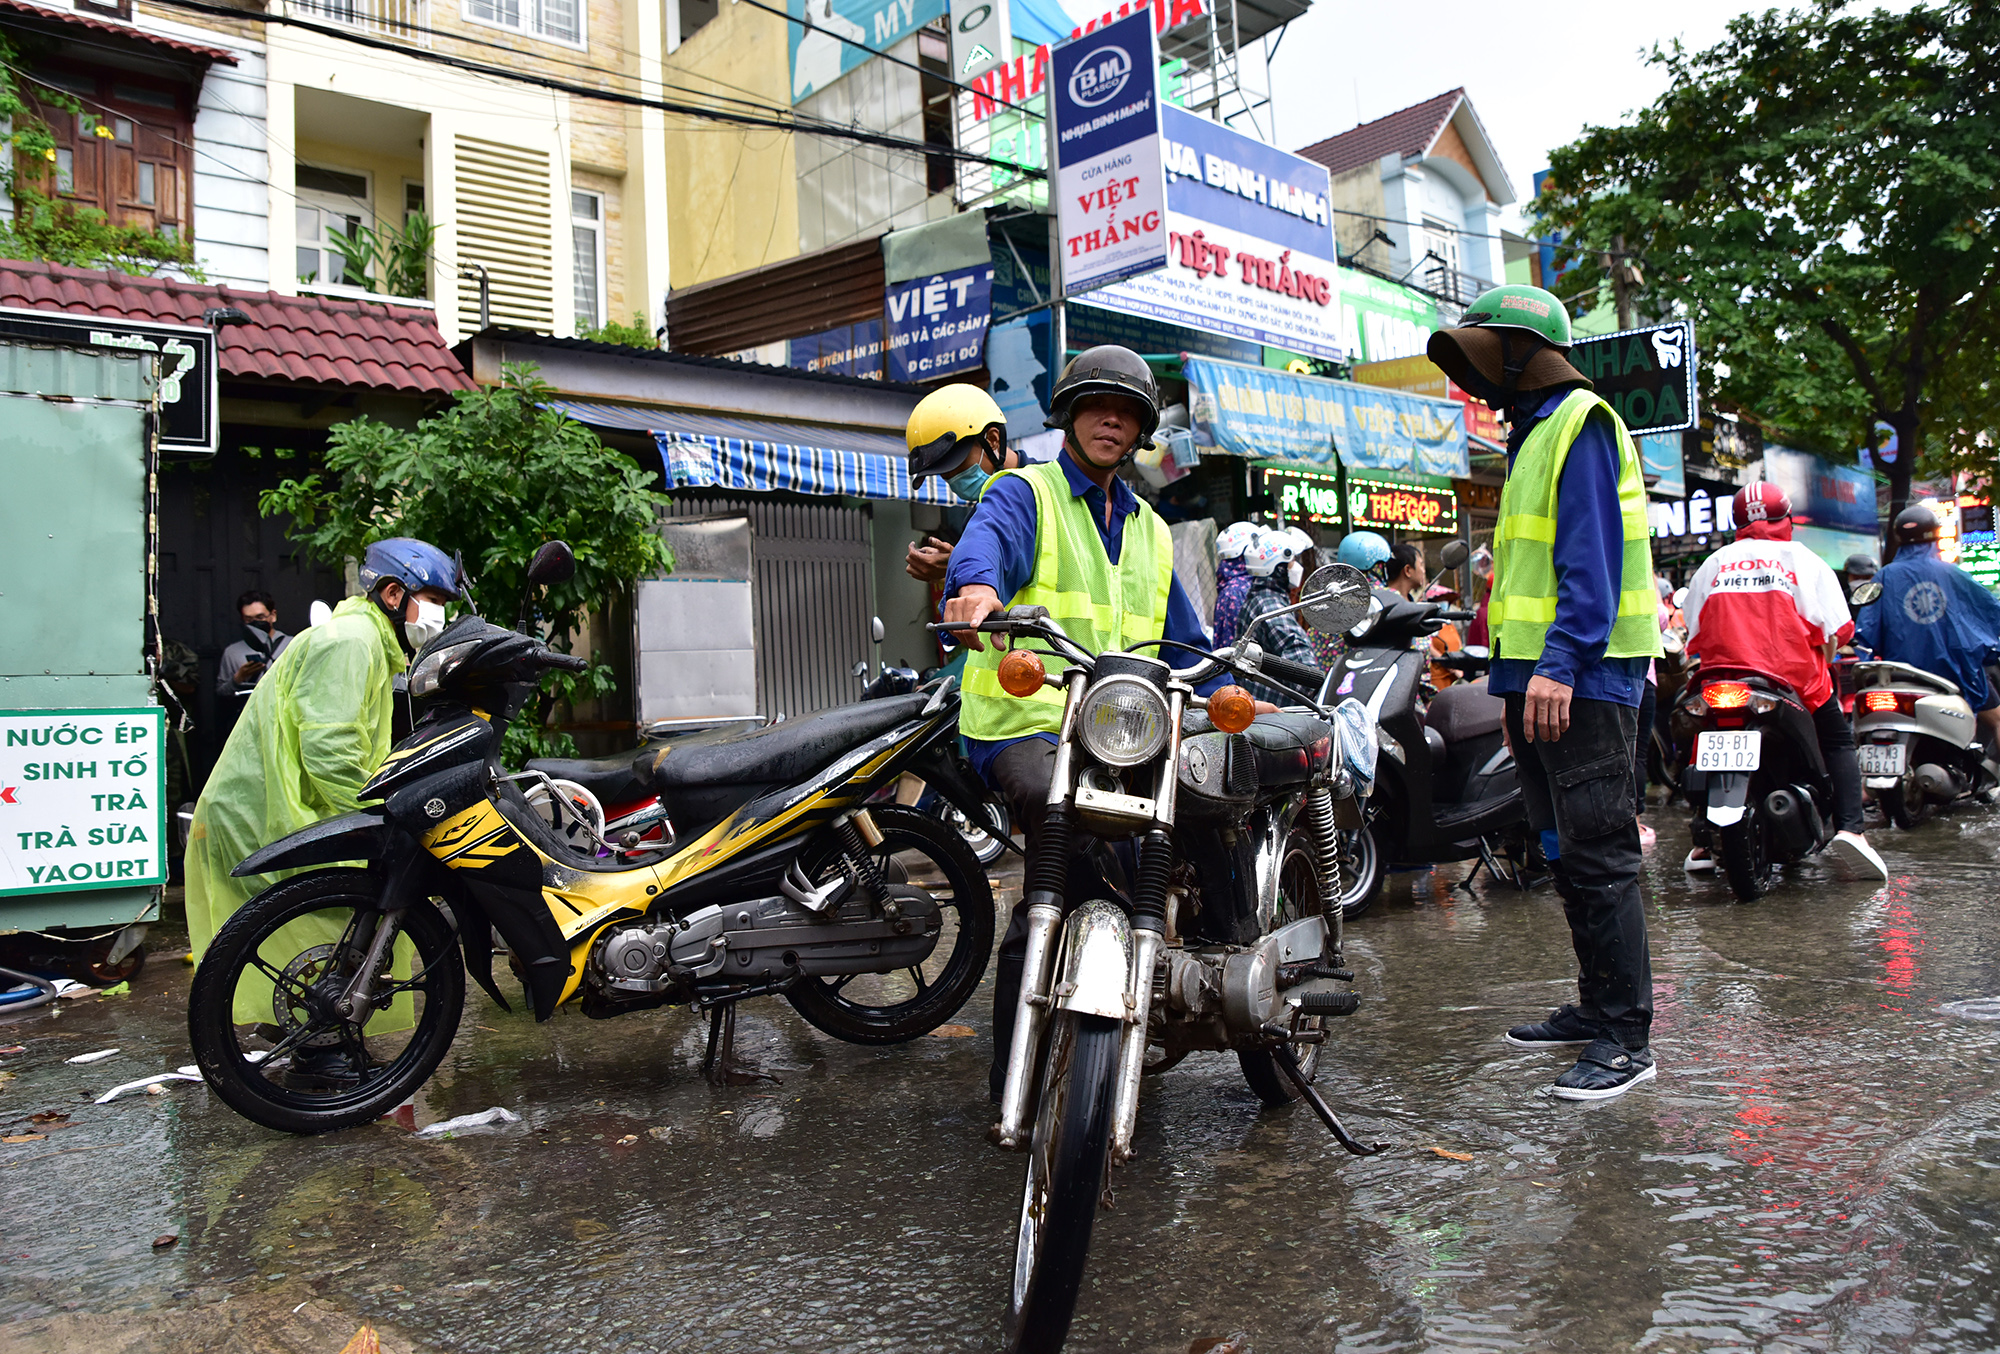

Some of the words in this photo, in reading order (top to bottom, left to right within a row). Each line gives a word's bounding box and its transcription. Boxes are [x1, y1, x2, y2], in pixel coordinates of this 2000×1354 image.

[971, 44, 1051, 121] NHA
[1080, 57, 1121, 91] BM
[1081, 78, 1120, 99] PLASCO
[1061, 121, 1092, 143] NHỰA
[1081, 166, 1103, 181] CỬA
[1103, 154, 1133, 174] HÀNG
[1077, 175, 1140, 215] VIỆT
[1067, 210, 1160, 258] THẮNG
[1236, 248, 1332, 308] THẮNG
[888, 275, 975, 323] VIỆT
[845, 343, 867, 363] BÁN
[868, 341, 880, 357] XI
[911, 327, 930, 344] VÀ
[931, 319, 955, 341] CÁC
[957, 313, 979, 335] SẢN
[935, 350, 956, 368] 521
[959, 337, 979, 361] ĐỖ
[1568, 335, 1653, 379] NHA
[1356, 363, 1407, 384] HOÀNG
[7, 722, 104, 747] NƯỚC
[115, 721, 148, 744] ÉP
[23, 761, 98, 781] SINH
[107, 751, 148, 778] TỐ
[1700, 752, 1755, 768] 691.02
[1865, 761, 1898, 774] 0841
[91, 787, 149, 812] TRÀ
[16, 824, 78, 851] TRÀ
[87, 822, 149, 846] SỮA
[26, 858, 149, 885] YAOURT
